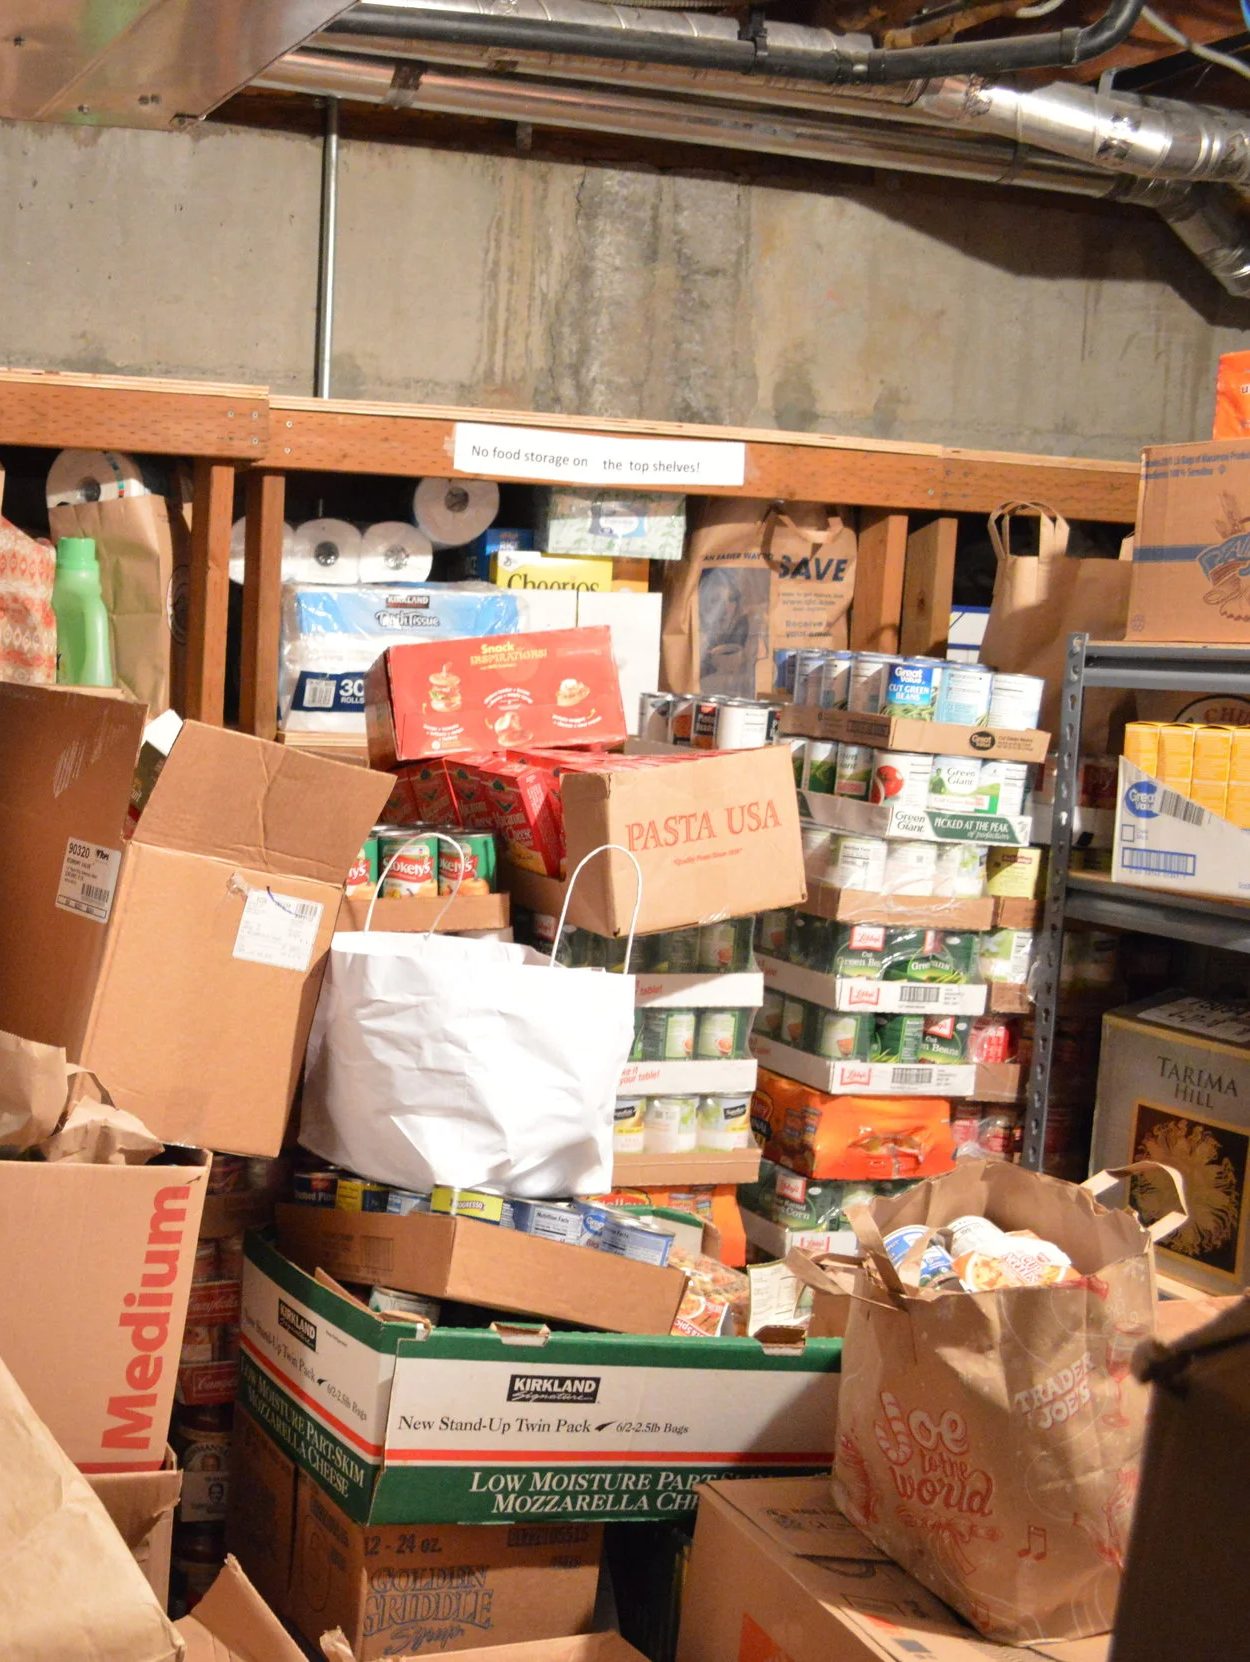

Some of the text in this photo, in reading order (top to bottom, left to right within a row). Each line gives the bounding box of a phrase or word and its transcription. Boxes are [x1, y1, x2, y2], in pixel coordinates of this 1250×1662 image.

[471, 444, 701, 474] No food storage on the top shelves!
[716, 552, 741, 560] EASIER
[743, 552, 761, 560] WAY
[778, 554, 848, 582] SAVE
[408, 612, 441, 628] Tissue
[480, 641, 515, 654] Snack
[894, 666, 923, 680] Great
[900, 675, 923, 685] Value
[339, 679, 364, 696] 30
[888, 684, 930, 694] CUT GREEN
[895, 691, 921, 702] BEANS
[946, 766, 976, 778] Green
[947, 776, 974, 786] Giant
[1135, 801, 1155, 813] Val
[624, 799, 783, 852] PASTA USA
[894, 810, 926, 825] Green
[933, 817, 1009, 832] PICKED AT THE PEAK
[896, 821, 925, 834] Giant
[967, 829, 1010, 841] of perfection
[68, 842, 91, 859] 90320
[382, 853, 432, 875] Sokely's
[638, 1071, 660, 1082] table!
[1157, 1055, 1239, 1098] TARIMA
[1174, 1082, 1214, 1110] HILL
[536, 1212, 570, 1224] Nutrition Facts
[787, 1209, 810, 1221] Corn
[100, 1185, 191, 1450] Medium
[280, 1300, 316, 1342] KIRKLAND
[283, 1344, 298, 1367] Twin
[298, 1360, 316, 1385] Pack
[352, 1401, 368, 1422] Bags
[513, 1377, 597, 1394] KIRKLAND
[1013, 1351, 1096, 1414] TRADER
[511, 1390, 593, 1403] Signature
[1038, 1379, 1092, 1431] JOE'S
[258, 1377, 305, 1434] MOISTURE
[307, 1420, 365, 1488] PART-SKIM
[397, 1415, 689, 1436] New Stand-Up Twin Pack 6/2-2.5lb Bags
[873, 1391, 971, 1469] Joe
[251, 1389, 349, 1498] MOZZARELLA CHEESE
[920, 1450, 941, 1475] to
[469, 1471, 528, 1493] LOW
[528, 1471, 654, 1493] MOISTURE
[889, 1464, 994, 1517] World
[490, 1491, 699, 1514] MOZZARELLA CHE
[370, 1565, 489, 1593] GOLDEN
[363, 1589, 495, 1638] GRIDDLE
